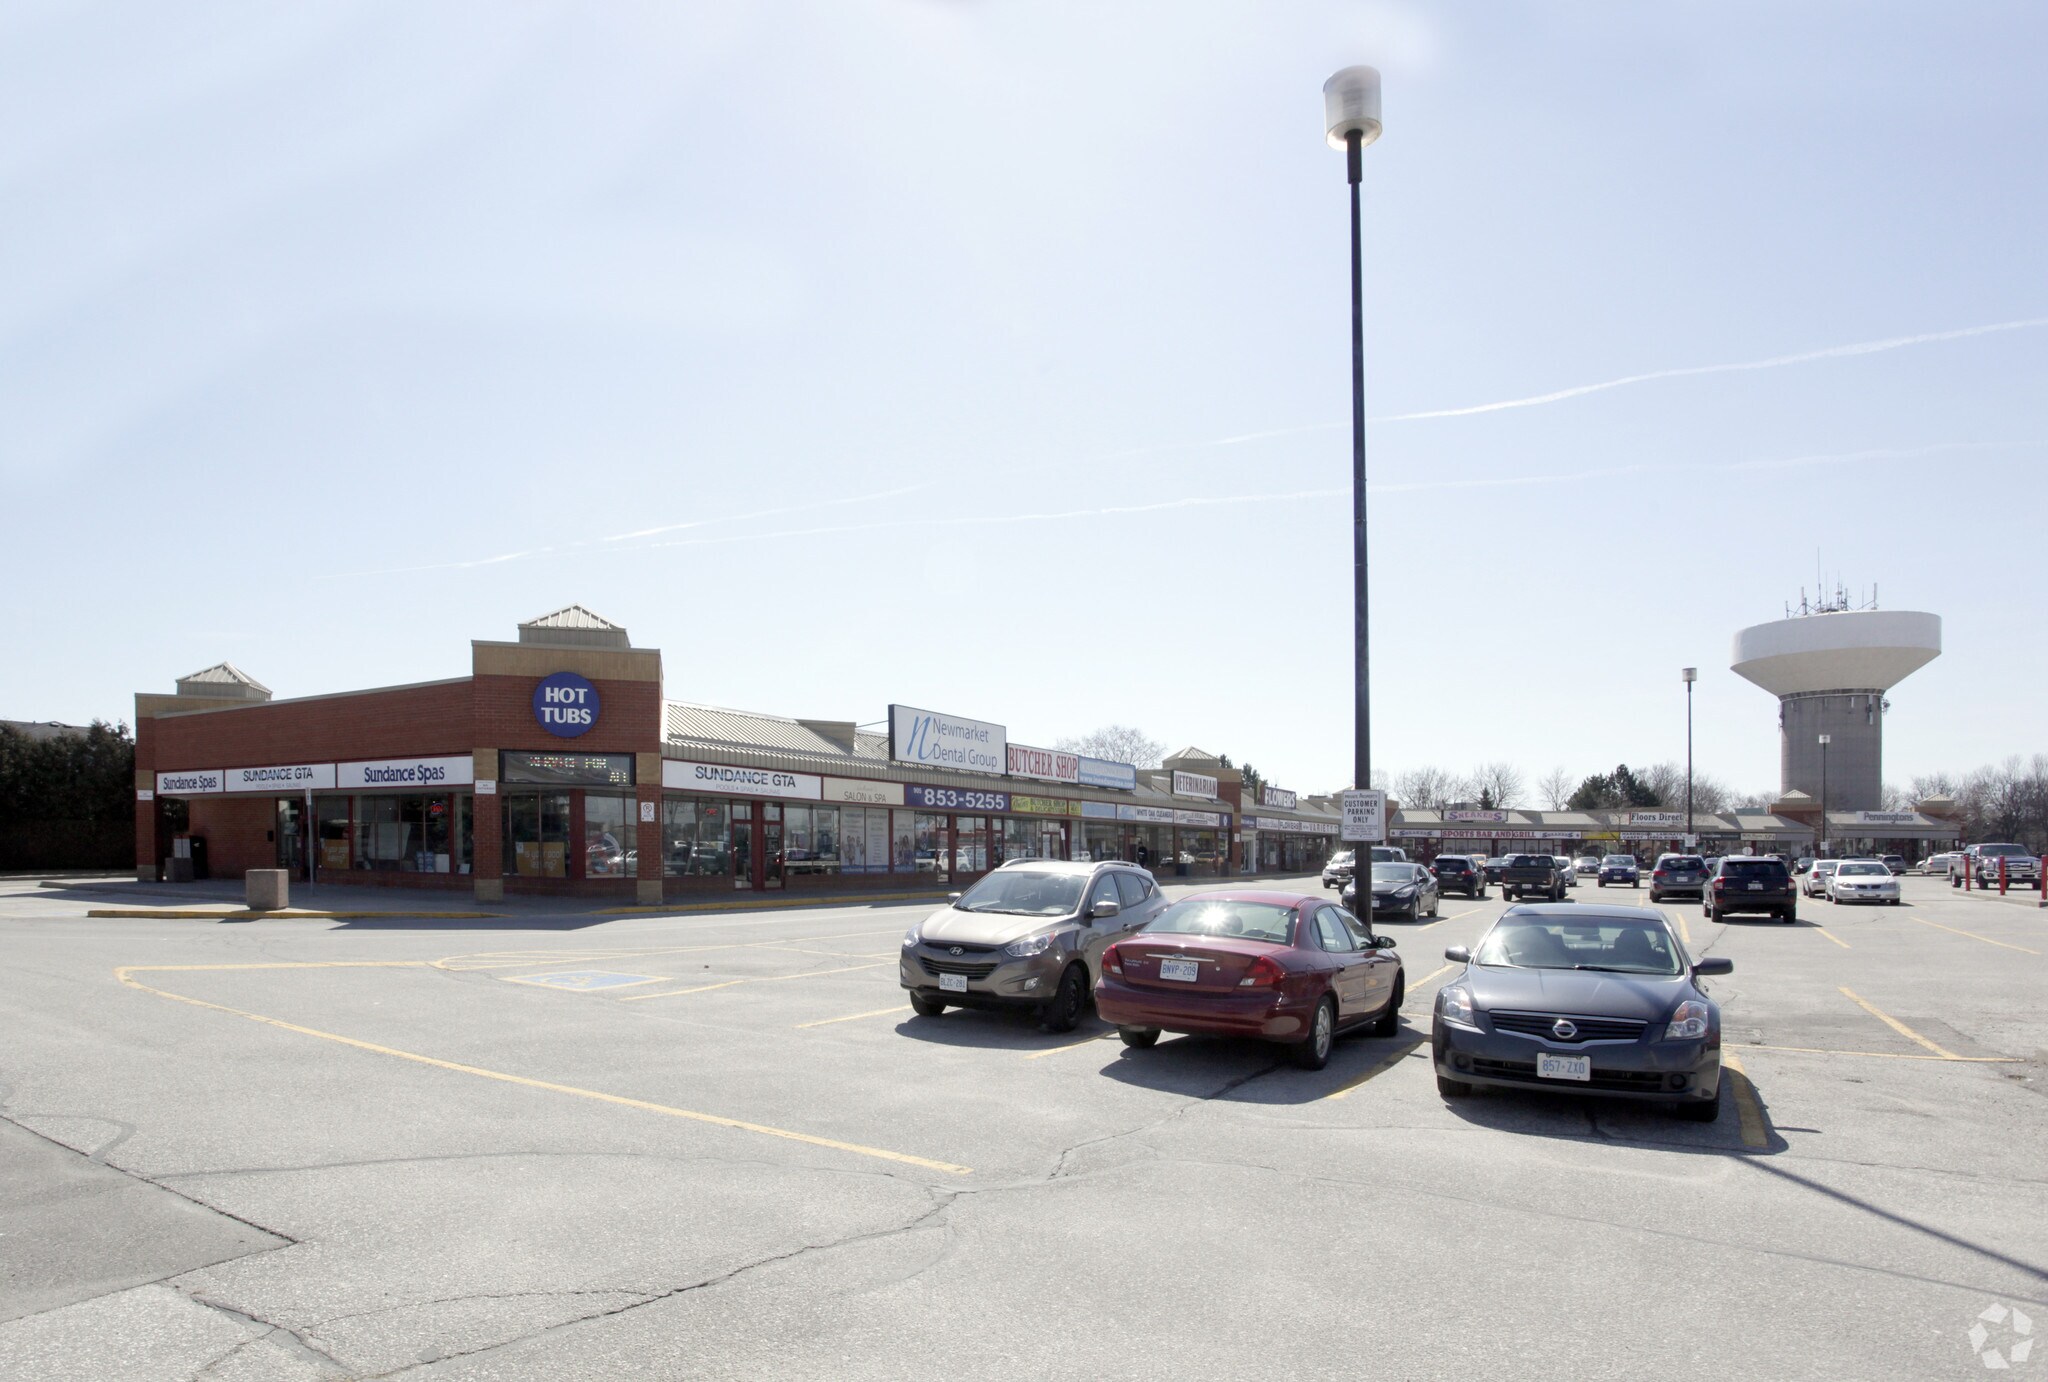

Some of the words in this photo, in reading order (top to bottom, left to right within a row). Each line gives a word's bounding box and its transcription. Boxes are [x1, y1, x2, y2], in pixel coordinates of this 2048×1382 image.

[545, 687, 588, 704] HOT
[541, 707, 592, 725] TUBS
[933, 717, 989, 743] Newmarket
[933, 743, 966, 763] Dental
[968, 749, 998, 771] Group
[1008, 747, 1053, 777] BUTCHER
[1056, 755, 1078, 780] SHOP
[163, 777, 198, 791] Sundance
[199, 775, 217, 791] Spas
[243, 768, 292, 783] SUNDANCE
[294, 766, 313, 780] GTA
[364, 766, 416, 783] Sundance
[417, 764, 445, 785] Spas
[695, 765, 769, 785] SUNDANCE
[772, 774, 796, 788] GTA
[1175, 774, 1217, 797] VETERINARIAN
[844, 791, 867, 802] SALON
[874, 793, 887, 803] SPA
[924, 788, 1004, 810] 853-5255
[1264, 788, 1296, 809] FLOWERS
[1136, 808, 1148, 817] WHITE
[1156, 810, 1173, 818] CLEANERS
[1448, 811, 1503, 821] SNEAKERS
[1631, 812, 1657, 821] Floors
[1659, 812, 1683, 821] Direct
[1863, 811, 1914, 824] Penningtons
[1442, 830, 1474, 838] SPORTS
[1476, 830, 1493, 838] BAR
[1494, 830, 1512, 839] AND
[1512, 831, 1536, 839] GRILL
